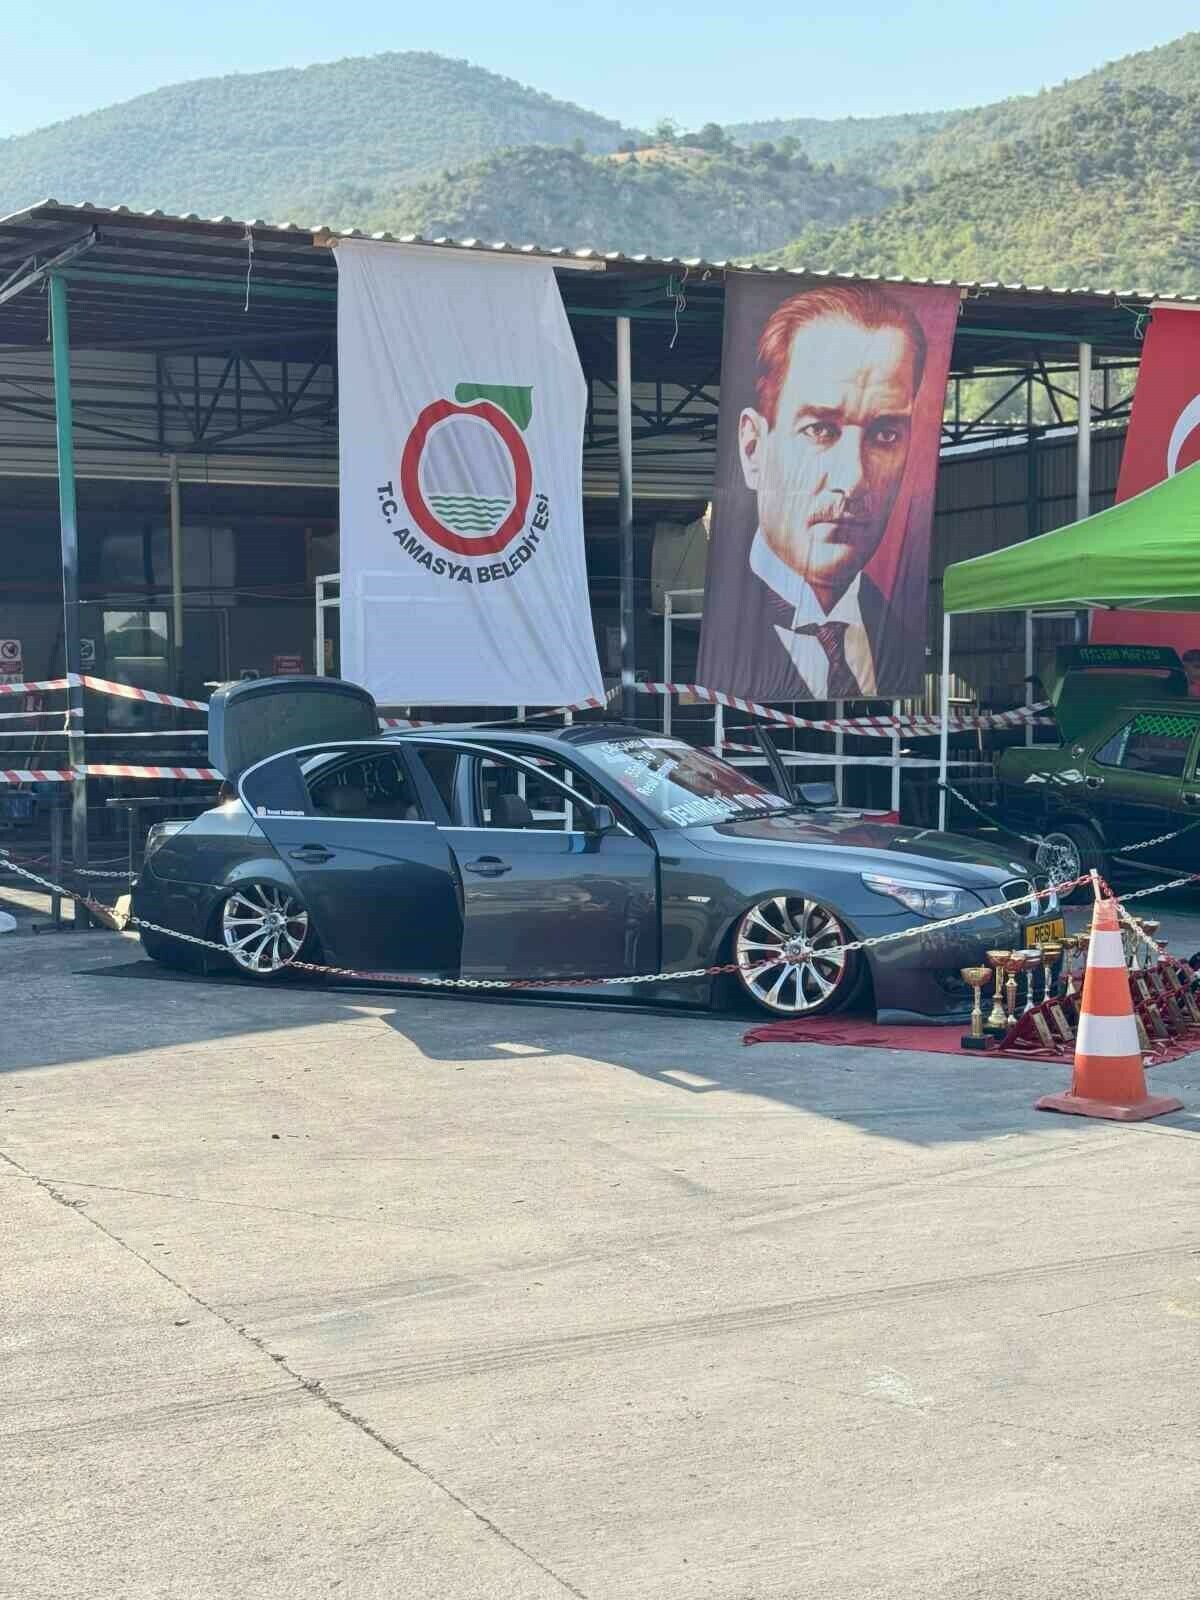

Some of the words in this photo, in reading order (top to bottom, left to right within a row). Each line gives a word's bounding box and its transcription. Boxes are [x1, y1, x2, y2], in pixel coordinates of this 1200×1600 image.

[377, 481, 398, 524] T.C.
[393, 528, 473, 584] AMASYA
[476, 493, 550, 584] BELEDİYESİ
